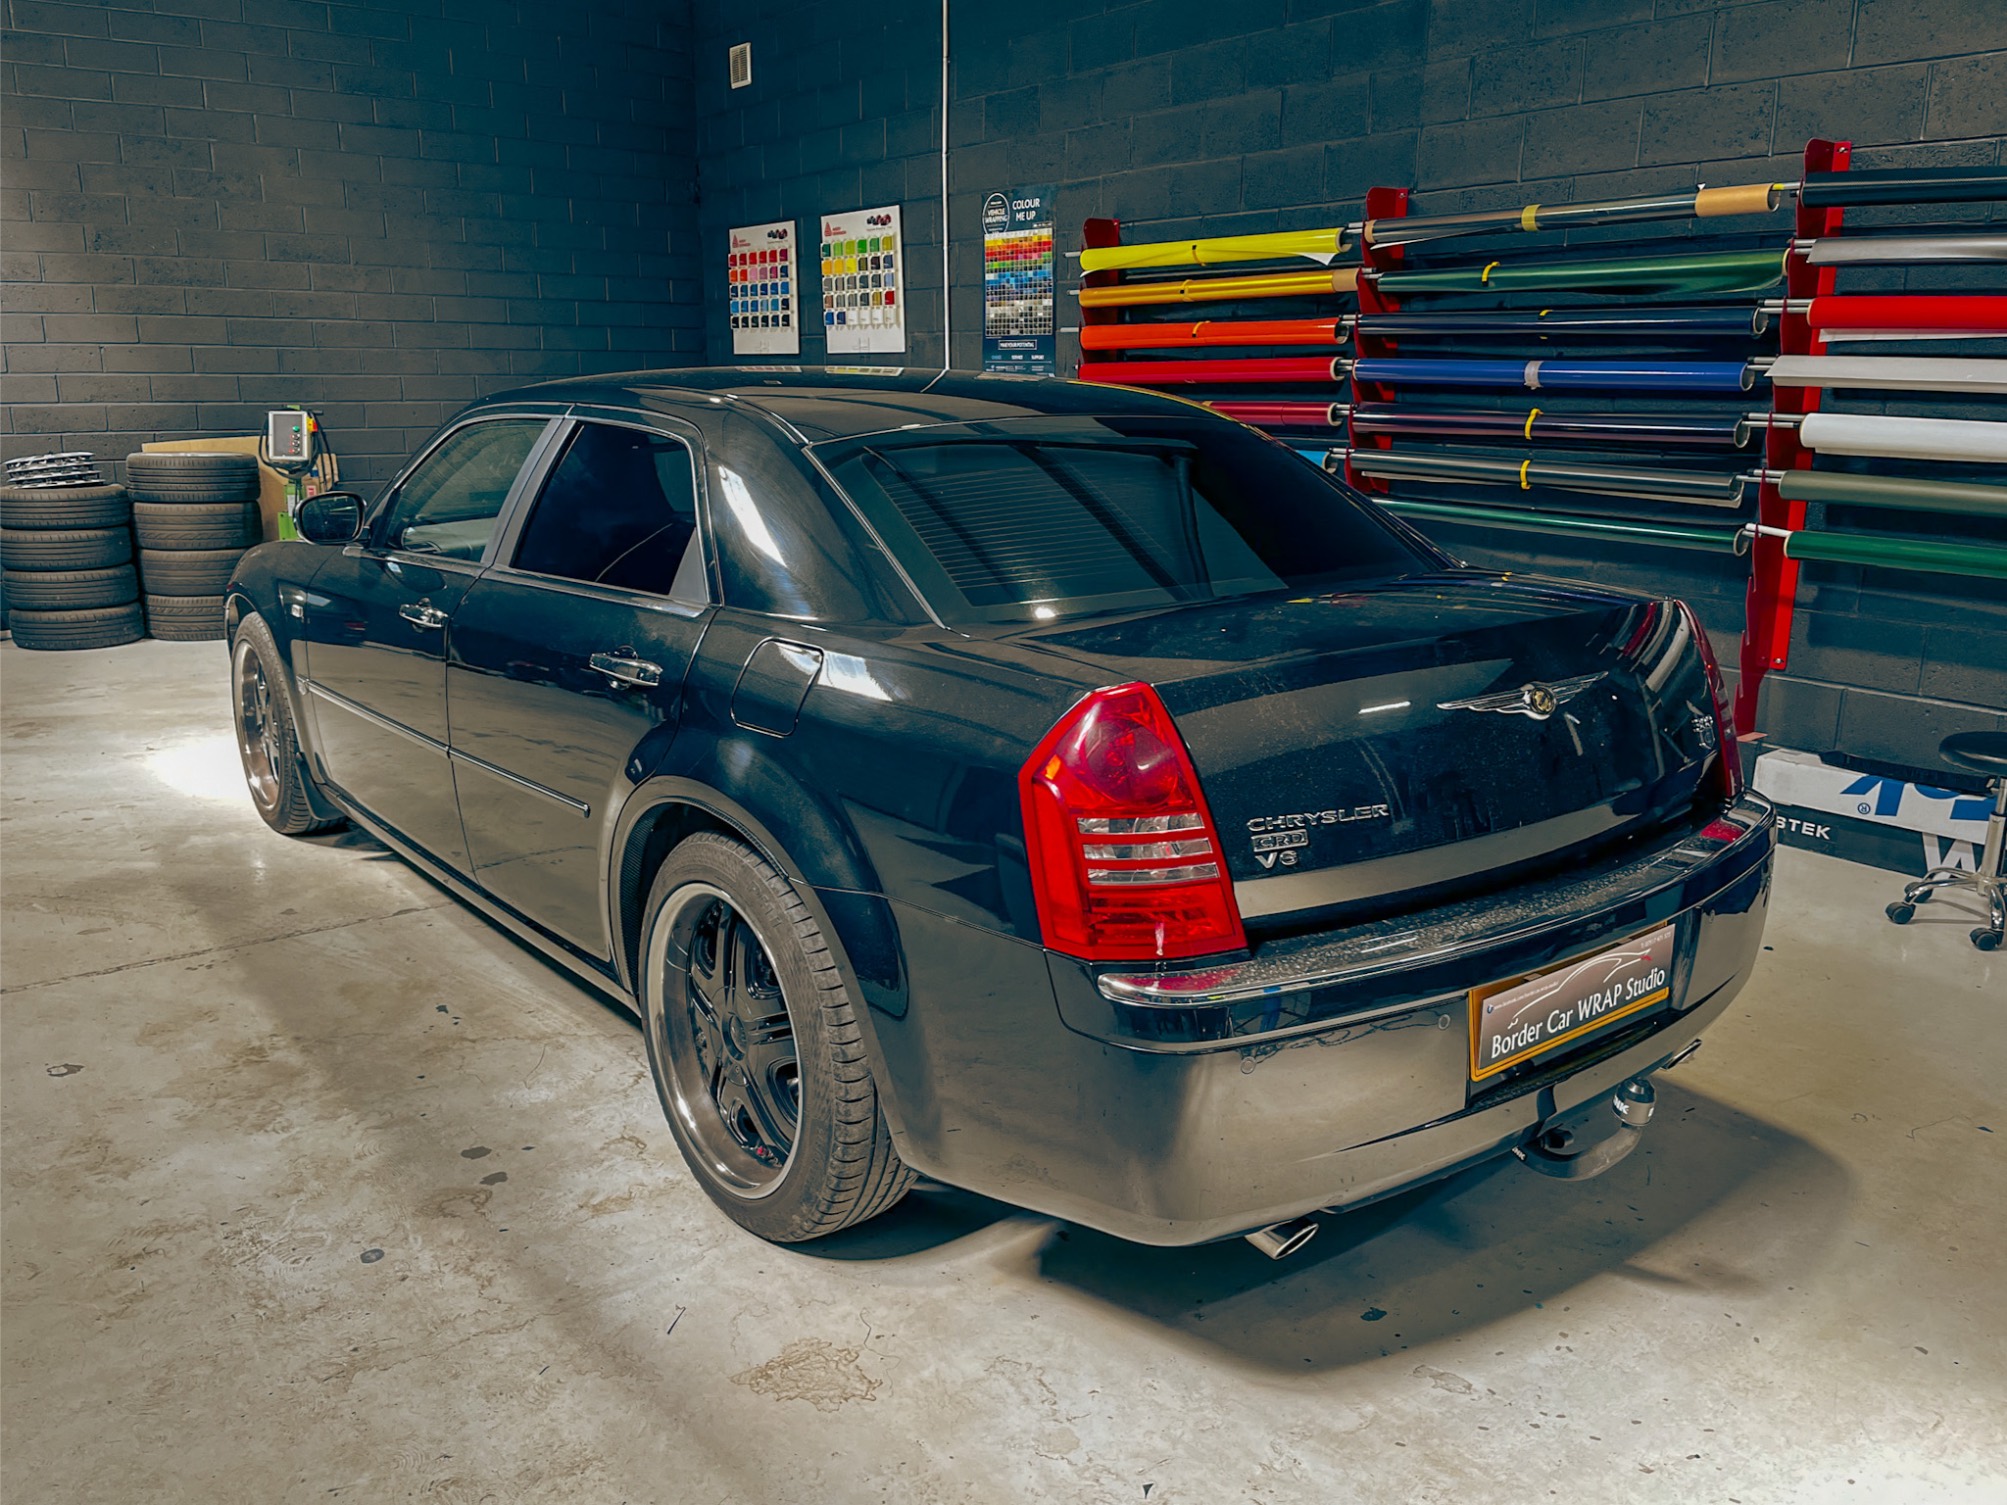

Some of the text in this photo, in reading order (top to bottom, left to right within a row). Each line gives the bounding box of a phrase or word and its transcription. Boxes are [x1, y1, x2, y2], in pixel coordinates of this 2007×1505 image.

[1012, 198, 1040, 211] COLOUR
[1015, 210, 1037, 222] ME UP
[1246, 804, 1389, 832] CHRYSLER
[1776, 815, 1831, 840] STEK
[1259, 832, 1305, 848] CRD
[1255, 850, 1298, 869] V6
[1491, 1021, 1544, 1059] Border
[1547, 1009, 1574, 1034] Car
[1577, 983, 1623, 1022] WRAP
[1625, 967, 1666, 1000] Studio
